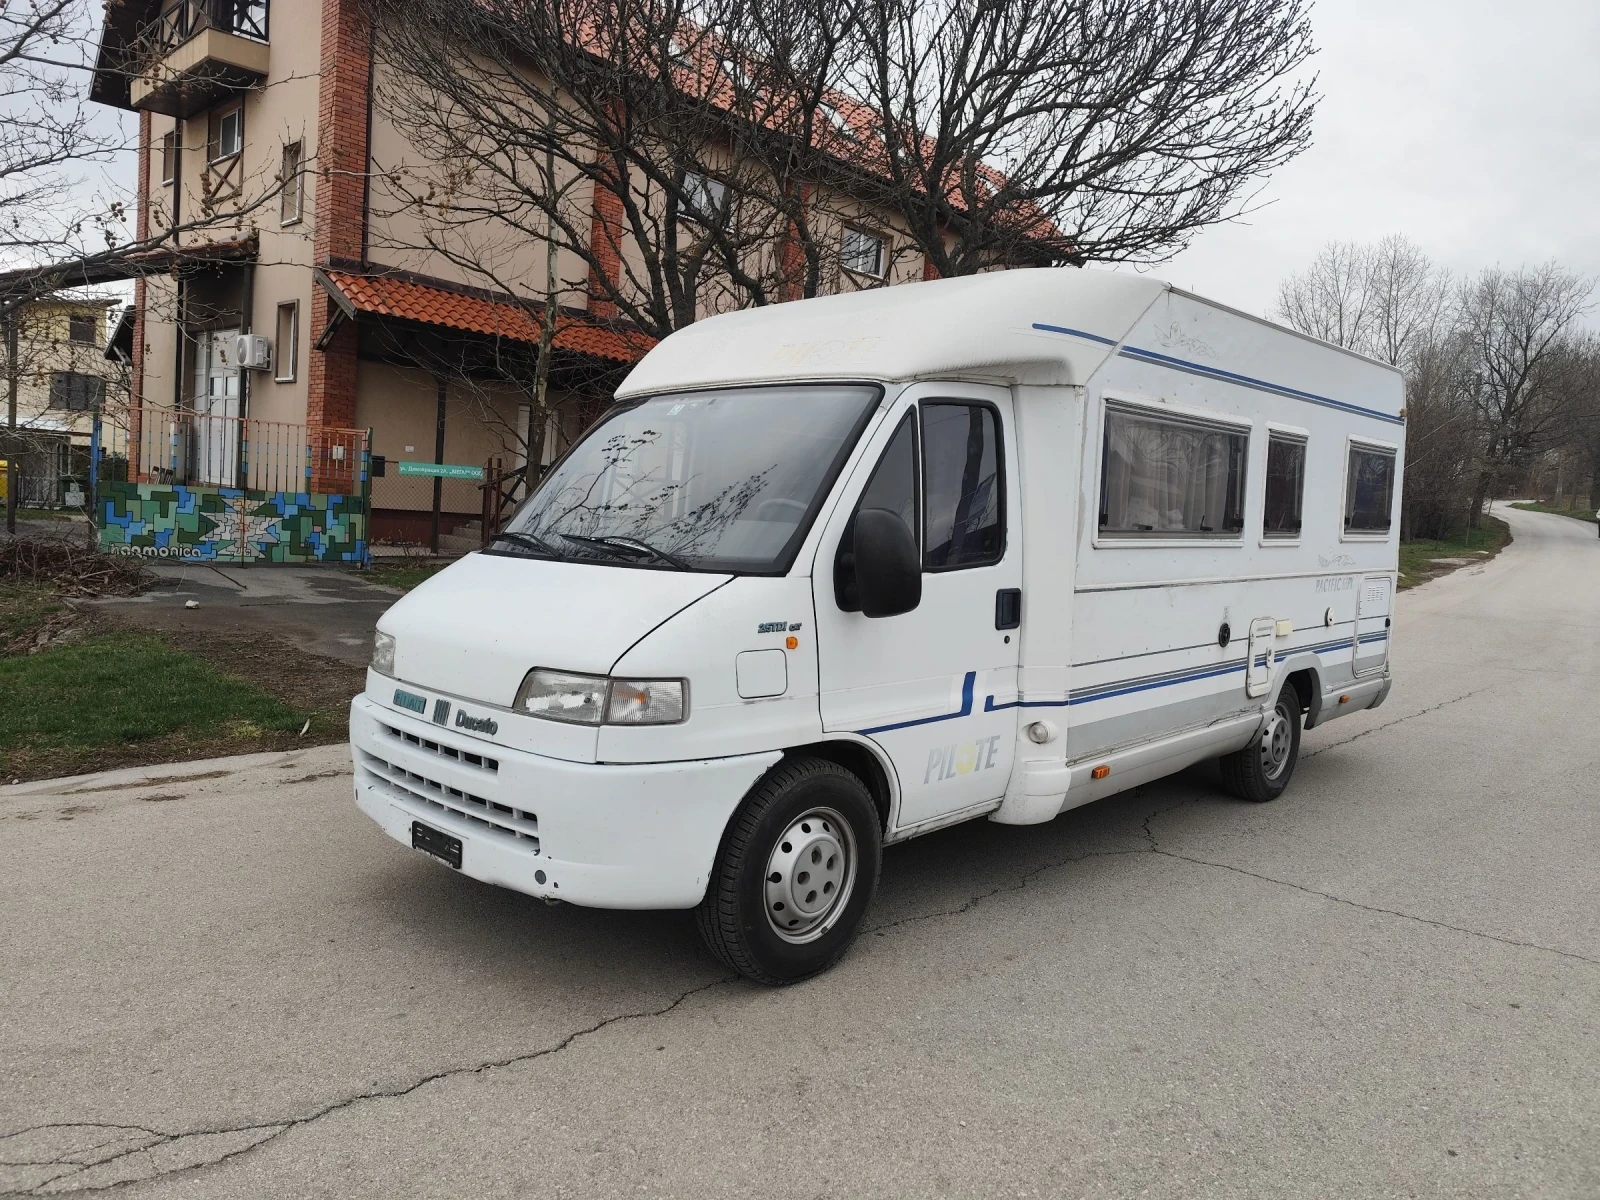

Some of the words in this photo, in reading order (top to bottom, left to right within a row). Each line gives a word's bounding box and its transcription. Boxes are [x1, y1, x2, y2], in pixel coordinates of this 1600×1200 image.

[393, 689, 427, 714] FIAT
[455, 708, 498, 735] Ducato
[923, 735, 1001, 784] PILOTE
